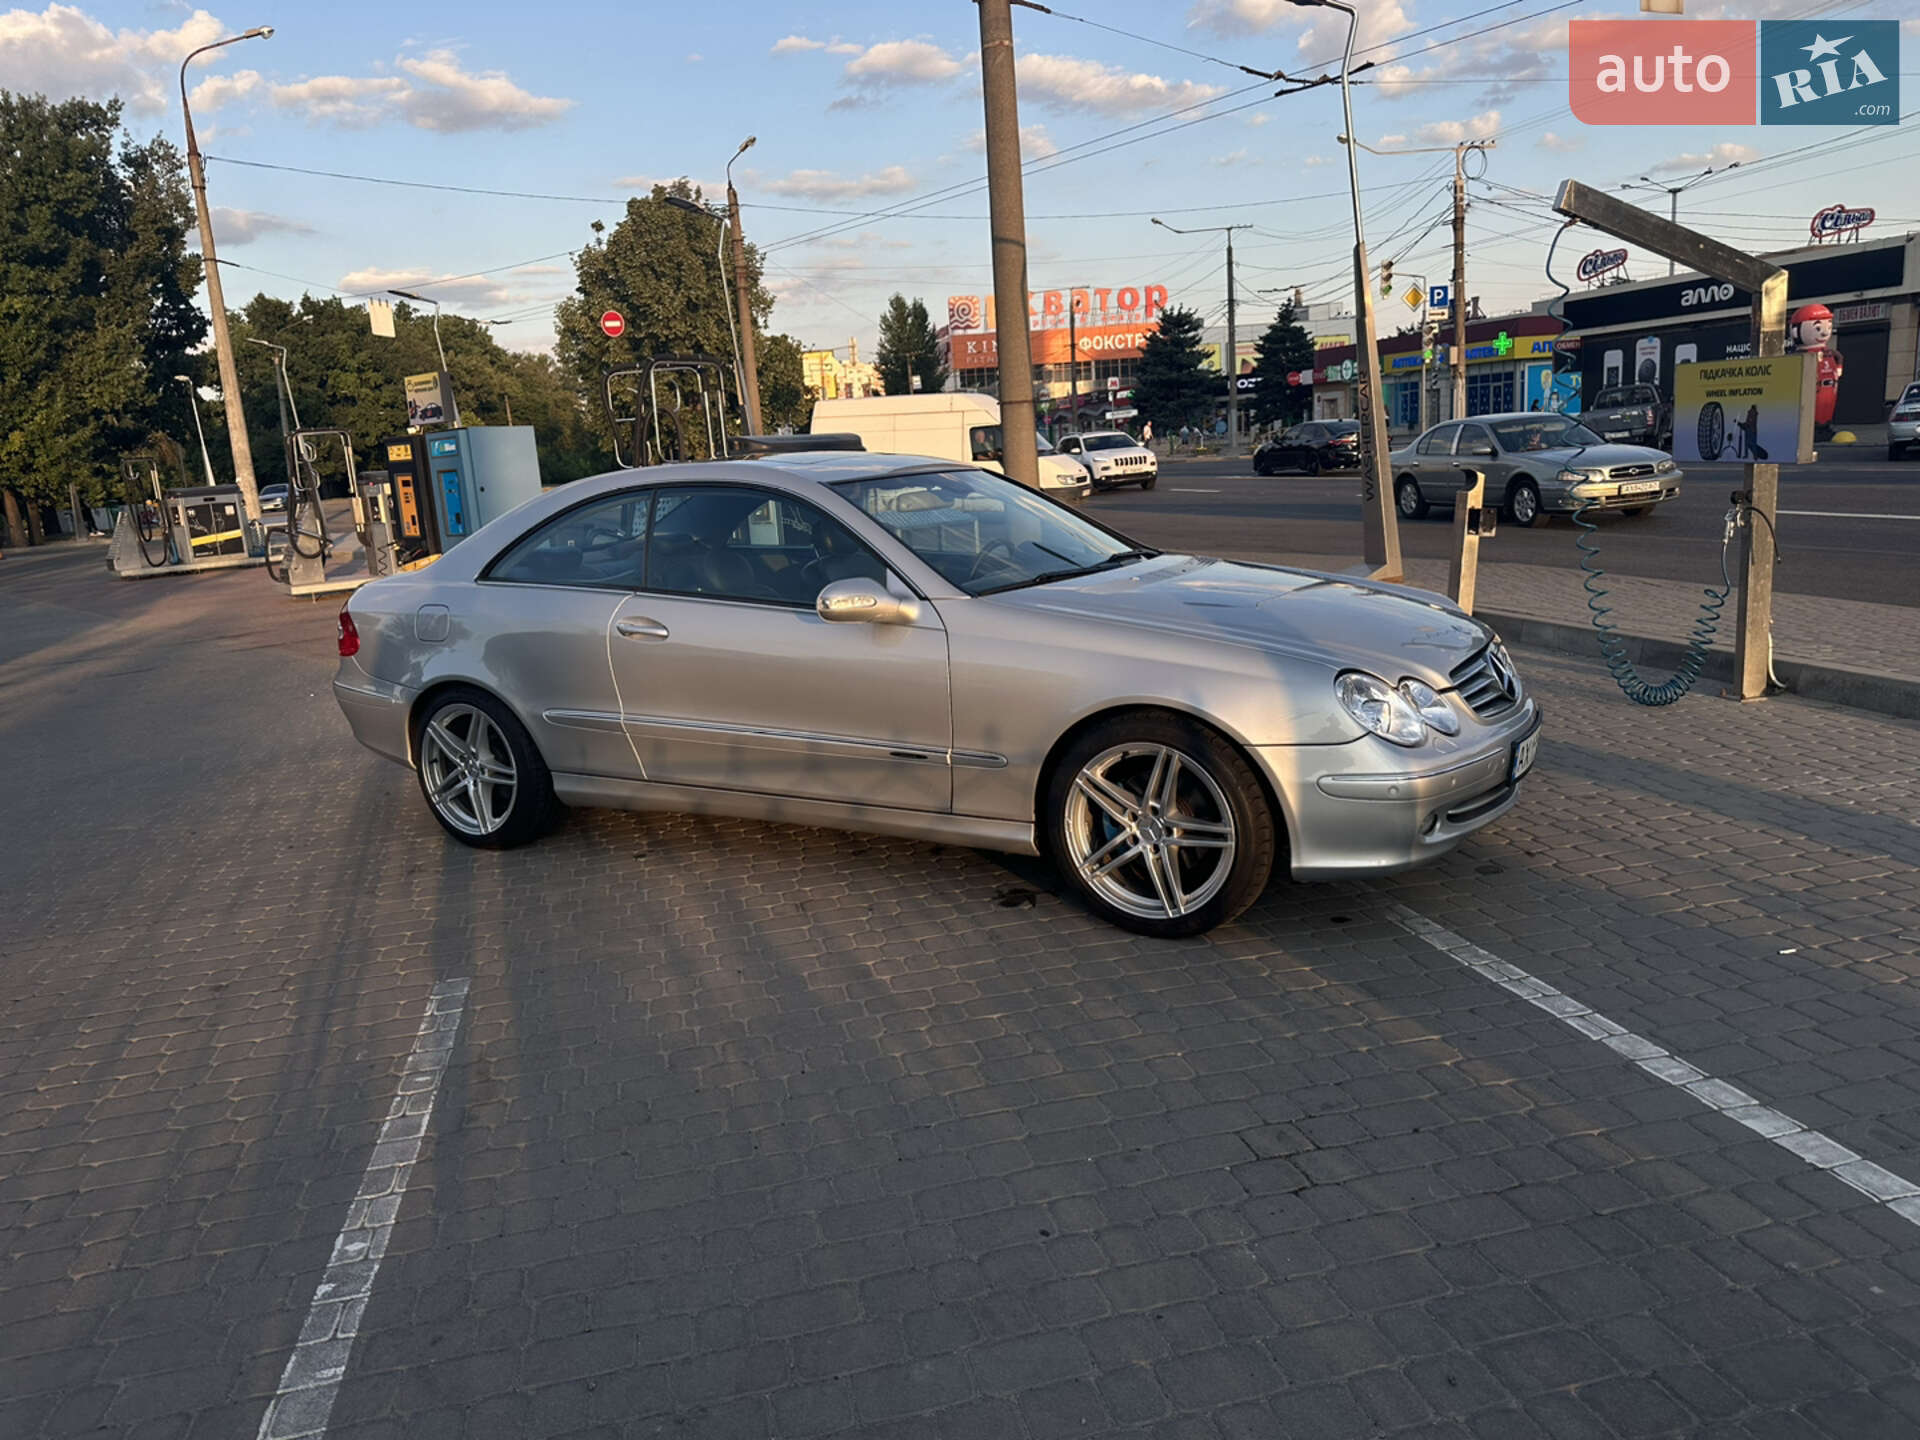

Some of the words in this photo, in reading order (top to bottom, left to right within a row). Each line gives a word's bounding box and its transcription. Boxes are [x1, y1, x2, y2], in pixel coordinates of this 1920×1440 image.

[1433, 289, 1444, 305] P
[1080, 331, 1150, 350] ФОКСТР
[1700, 366, 1743, 380] ПІДКАЧКА
[1745, 364, 1772, 377] КОЛІС
[1705, 389, 1727, 398] WHEEL
[1728, 387, 1764, 397] INFLATION
[1359, 370, 1376, 502] WASHERCAR
